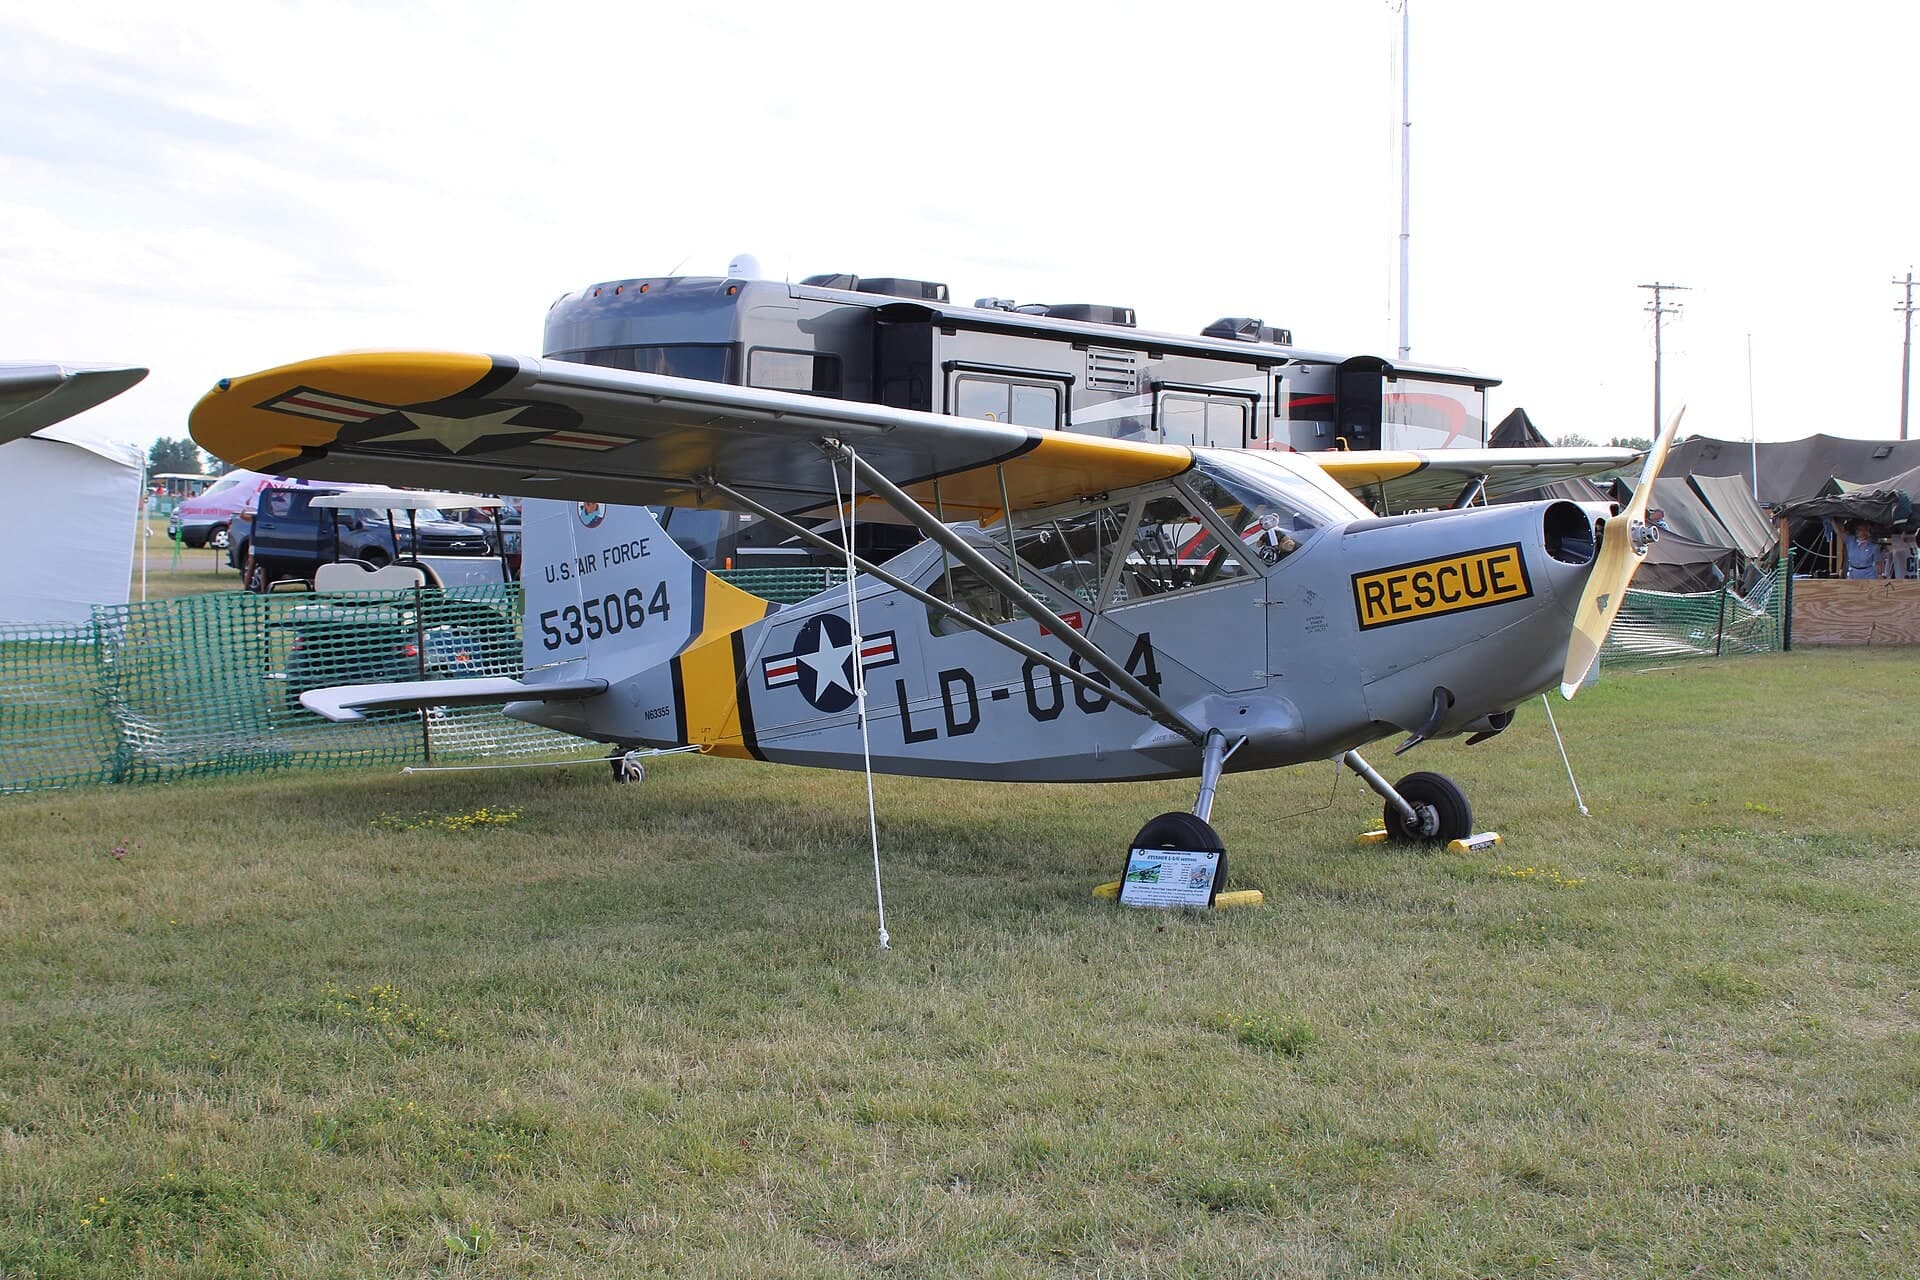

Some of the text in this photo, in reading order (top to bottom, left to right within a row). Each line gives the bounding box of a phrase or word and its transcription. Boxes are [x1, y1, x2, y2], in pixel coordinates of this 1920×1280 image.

[545, 538, 651, 583] U.S. AIR FORCE
[1363, 554, 1518, 619] RESCUE
[540, 581, 671, 650] 535064
[644, 706, 670, 720] N63355
